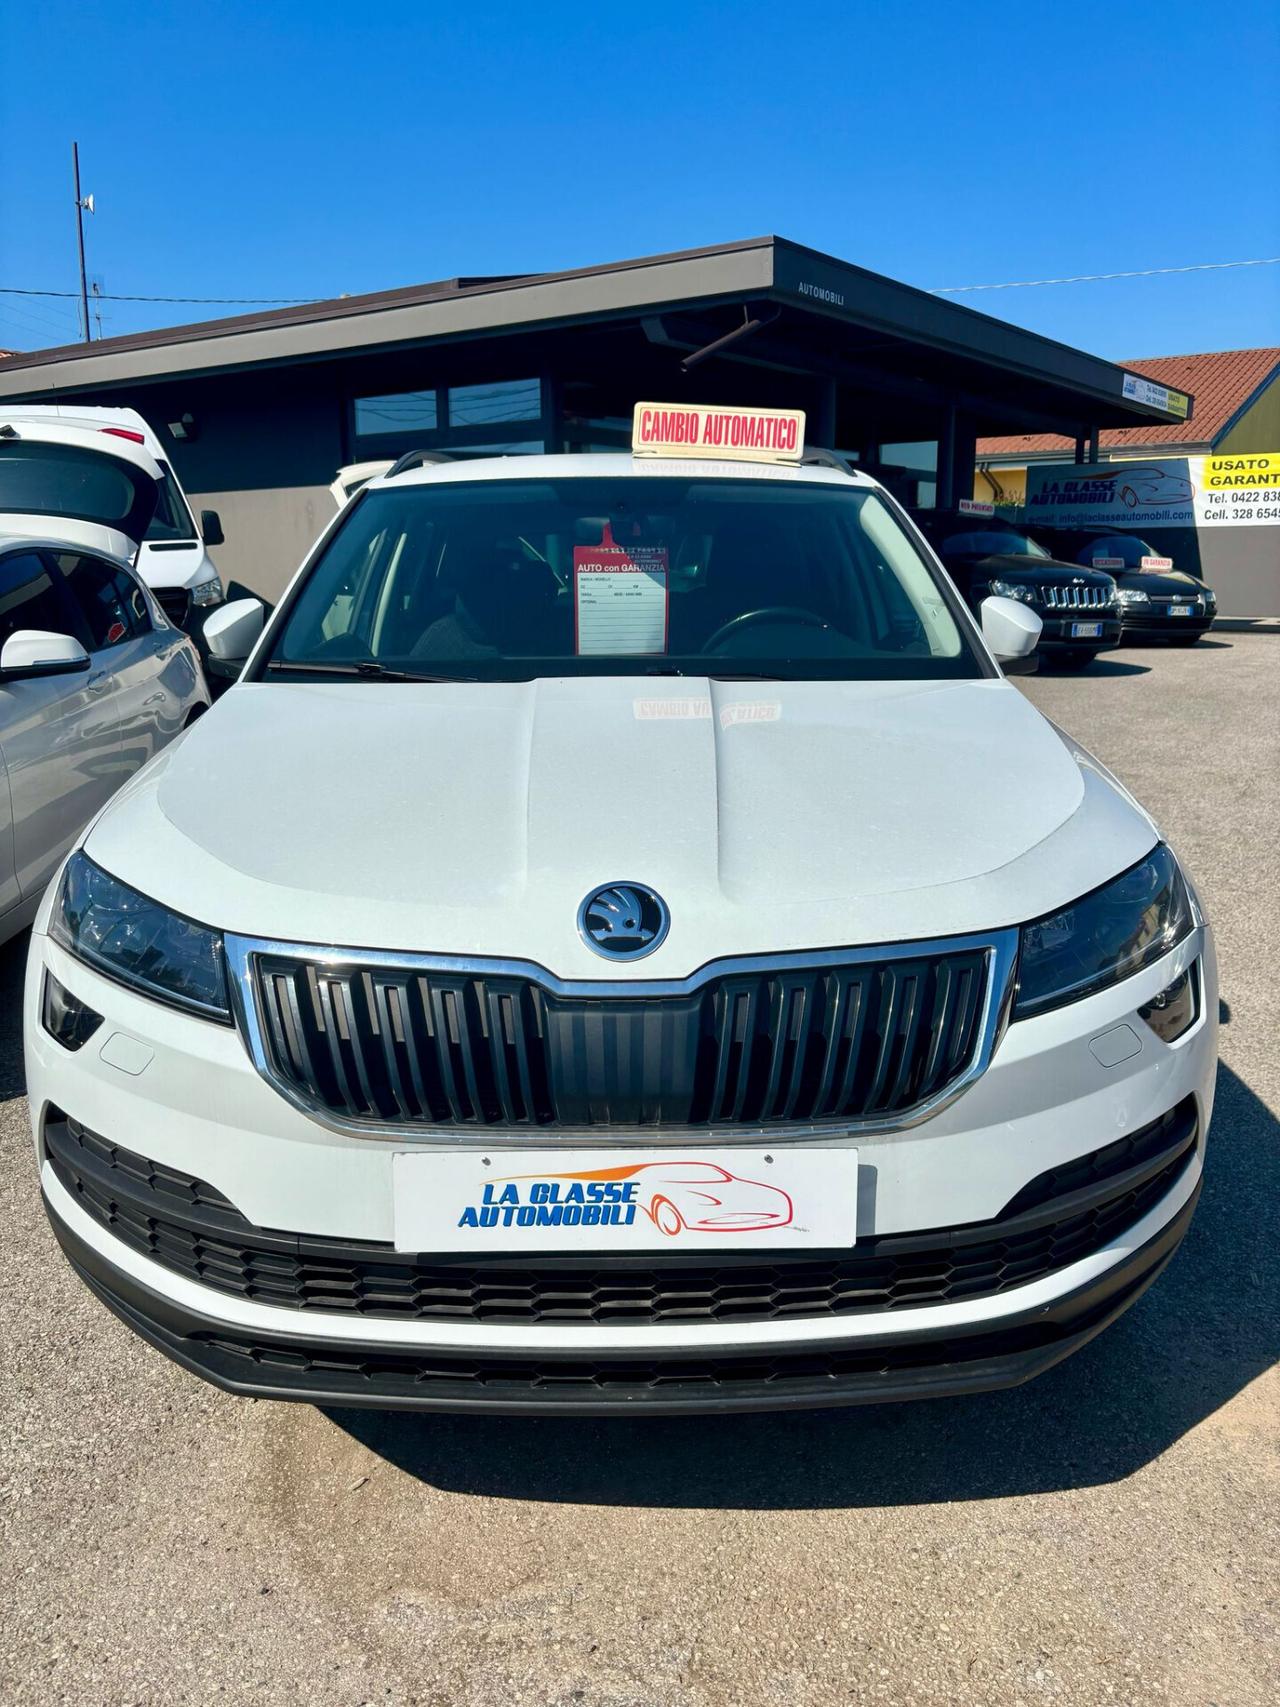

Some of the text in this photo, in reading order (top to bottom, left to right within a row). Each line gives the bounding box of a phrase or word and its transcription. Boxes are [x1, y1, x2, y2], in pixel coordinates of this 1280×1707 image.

[798, 281, 844, 306] AUTOMOBILI
[641, 410, 797, 450] CAMBIO AUTOMATICO
[1212, 459, 1270, 471] USATO
[1042, 479, 1118, 493] LA CLASSE
[1030, 491, 1116, 505] AUTOMOBILI
[1208, 493, 1227, 503] Tel.
[1232, 491, 1260, 502] 0422
[1204, 509, 1228, 520] Cell.
[1232, 508, 1253, 519] 328
[577, 563, 602, 572] AUTO
[621, 563, 665, 572] GARANZIA
[482, 1182, 640, 1205] LA CLASSE
[458, 1204, 637, 1227] AUTOMOBILI
